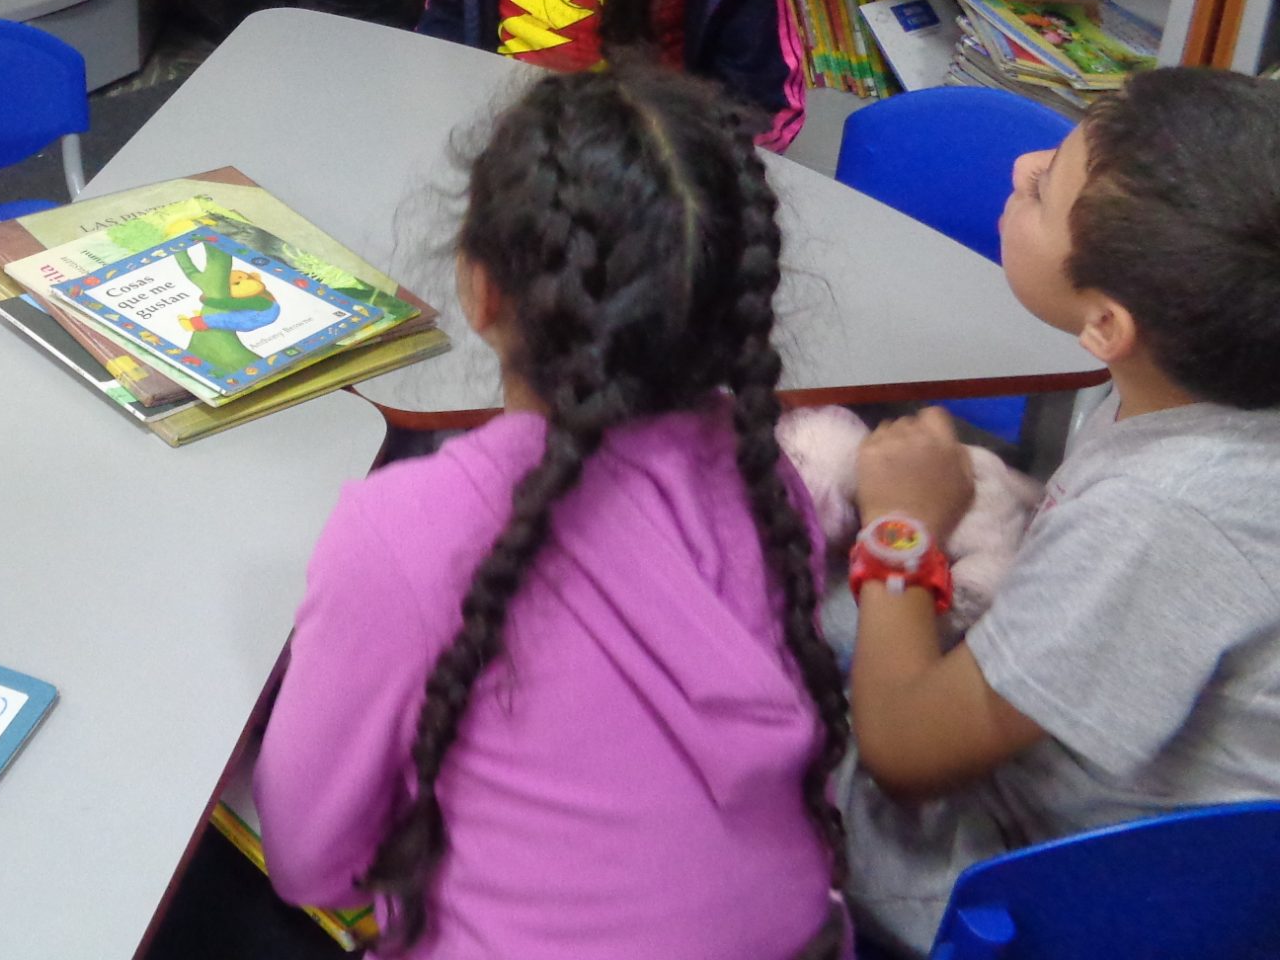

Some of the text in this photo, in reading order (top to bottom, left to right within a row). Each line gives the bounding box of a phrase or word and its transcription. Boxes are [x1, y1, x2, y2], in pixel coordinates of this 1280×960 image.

[106, 276, 155, 297] Cosas
[118, 281, 176, 309] que me
[136, 292, 191, 320] gustan
